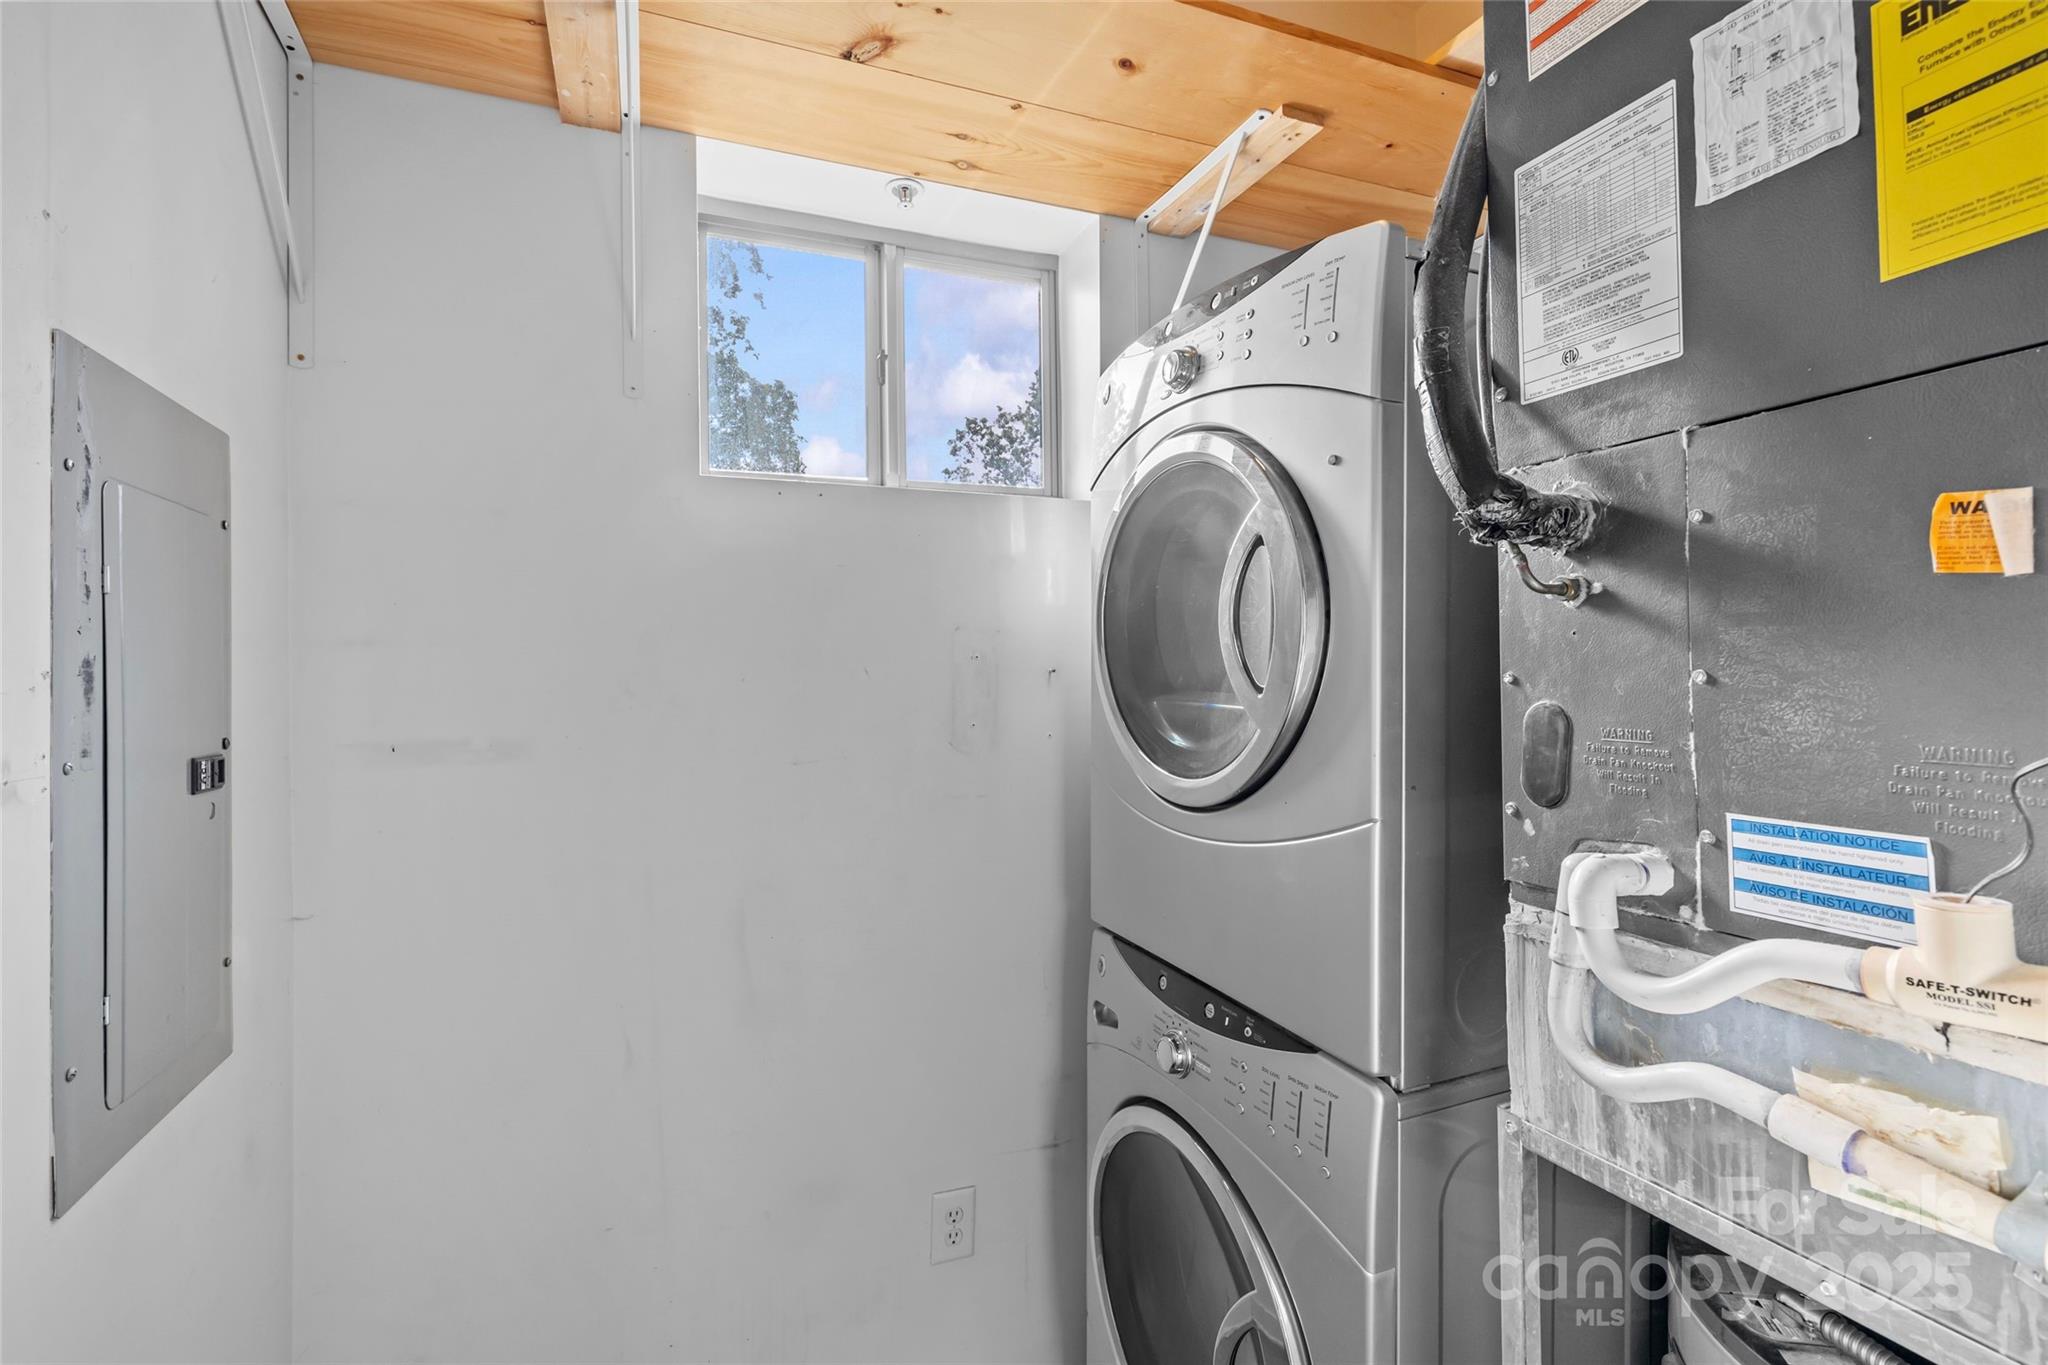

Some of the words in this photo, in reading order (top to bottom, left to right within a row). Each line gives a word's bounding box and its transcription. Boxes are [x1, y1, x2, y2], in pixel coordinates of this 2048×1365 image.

[1917, 38, 1964, 64] Compare
[1967, 26, 1985, 38] the
[1987, 7, 2025, 30] Energy
[1919, 50, 1961, 73] Furnace
[1964, 37, 1986, 52] with
[1989, 18, 2026, 39] Others
[1600, 727, 1654, 740] WARNING
[1586, 741, 1617, 755] Failure
[1620, 746, 1631, 755] to
[1634, 745, 1672, 759] Remove
[1918, 744, 2016, 765] WARNING
[1583, 755, 1607, 767] Drain
[1610, 757, 1627, 768] Pan
[1630, 759, 1676, 773] Knockout
[1893, 764, 1948, 781] Failure
[1955, 770, 1972, 783] to
[1596, 769, 1614, 780] Will
[1617, 770, 1646, 783] Result
[1609, 783, 1649, 799] Flooding
[1888, 781, 1929, 797] Drain
[1936, 785, 1966, 800] Pan
[1912, 800, 1942, 816] Will
[1949, 803, 2001, 821] Result
[1750, 823, 1840, 844] INSTALLATION
[1844, 834, 1900, 852] NOTICE
[1934, 820, 2004, 842] Flooding
[1750, 853, 1777, 866] AVIS
[1750, 883, 1787, 898] AVISO
[1790, 890, 1809, 902] DE
[1812, 894, 1909, 921] INSTALACIÓN
[1906, 976, 2032, 1007] SAFE-T-SWITCH
[1926, 991, 1974, 1007] MODEL
